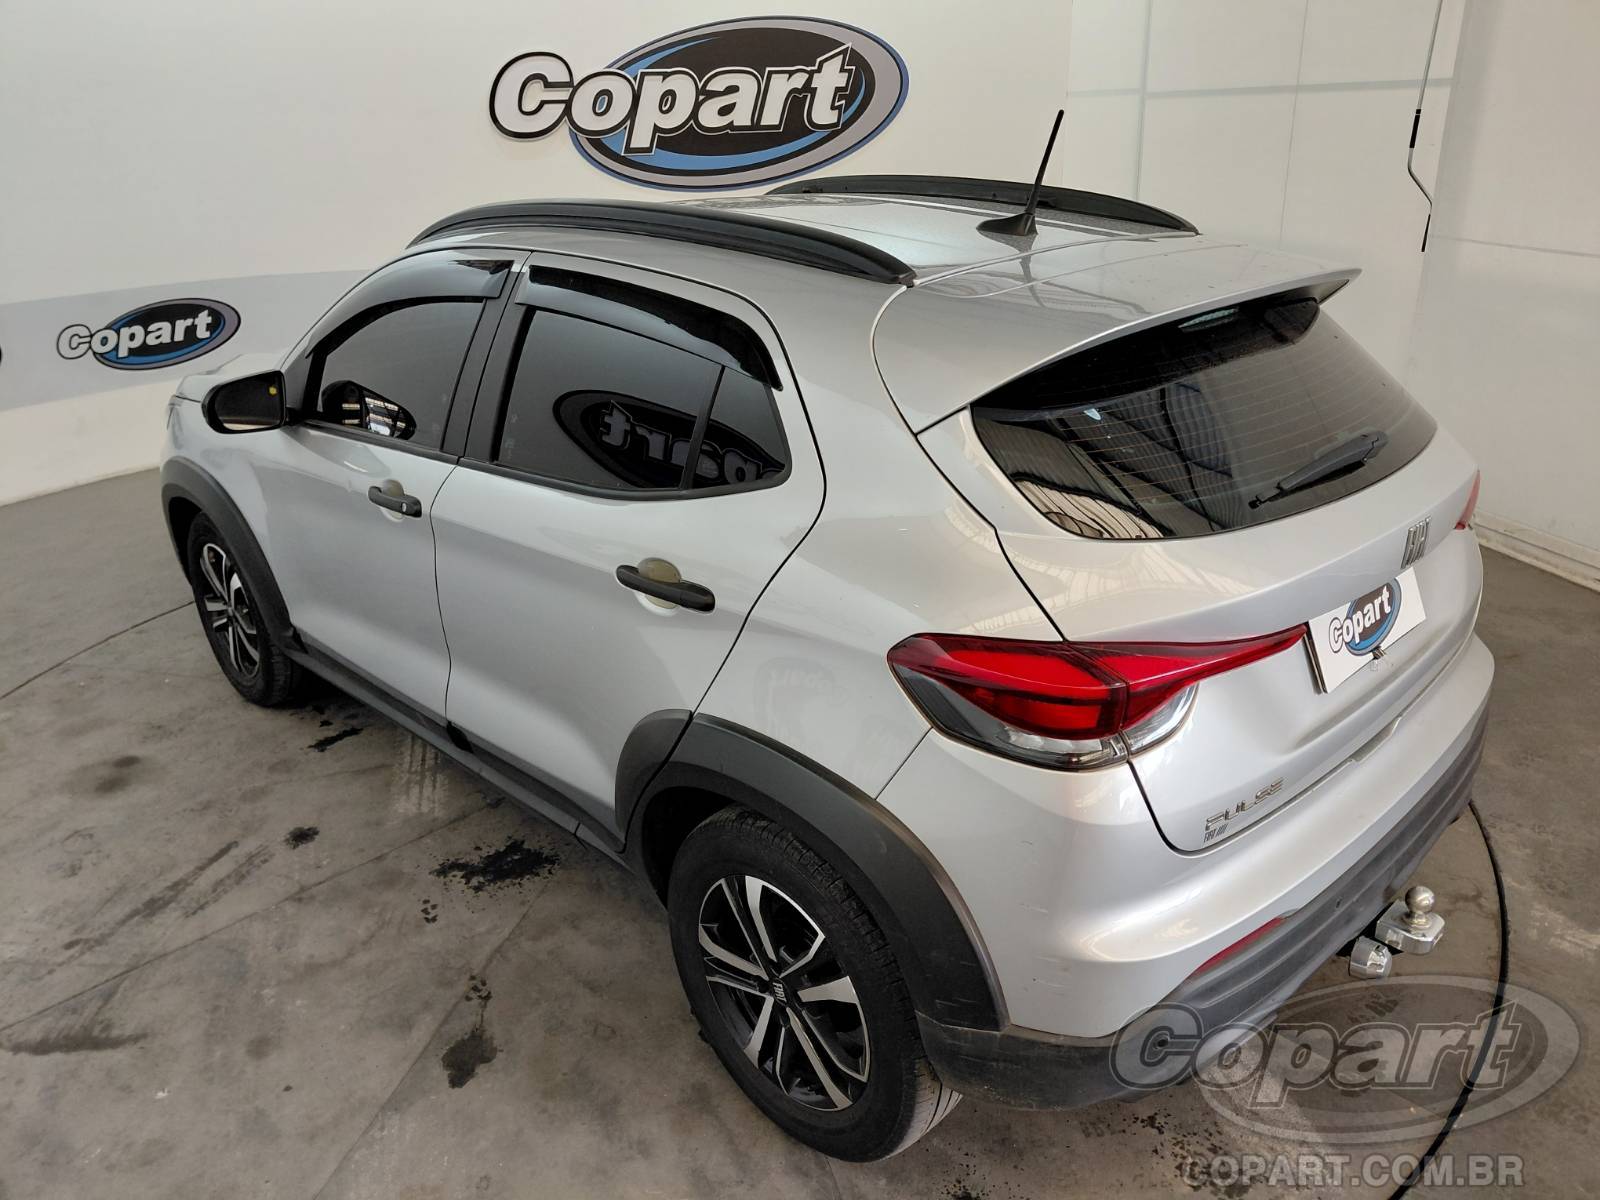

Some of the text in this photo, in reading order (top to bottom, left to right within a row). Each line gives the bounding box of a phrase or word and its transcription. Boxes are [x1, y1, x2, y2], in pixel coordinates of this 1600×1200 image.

[489, 43, 855, 155] Copart
[57, 309, 212, 359] Copart
[1329, 586, 1392, 653] Copart
[1204, 777, 1285, 831] PULSE
[772, 982, 787, 1002] FIAT
